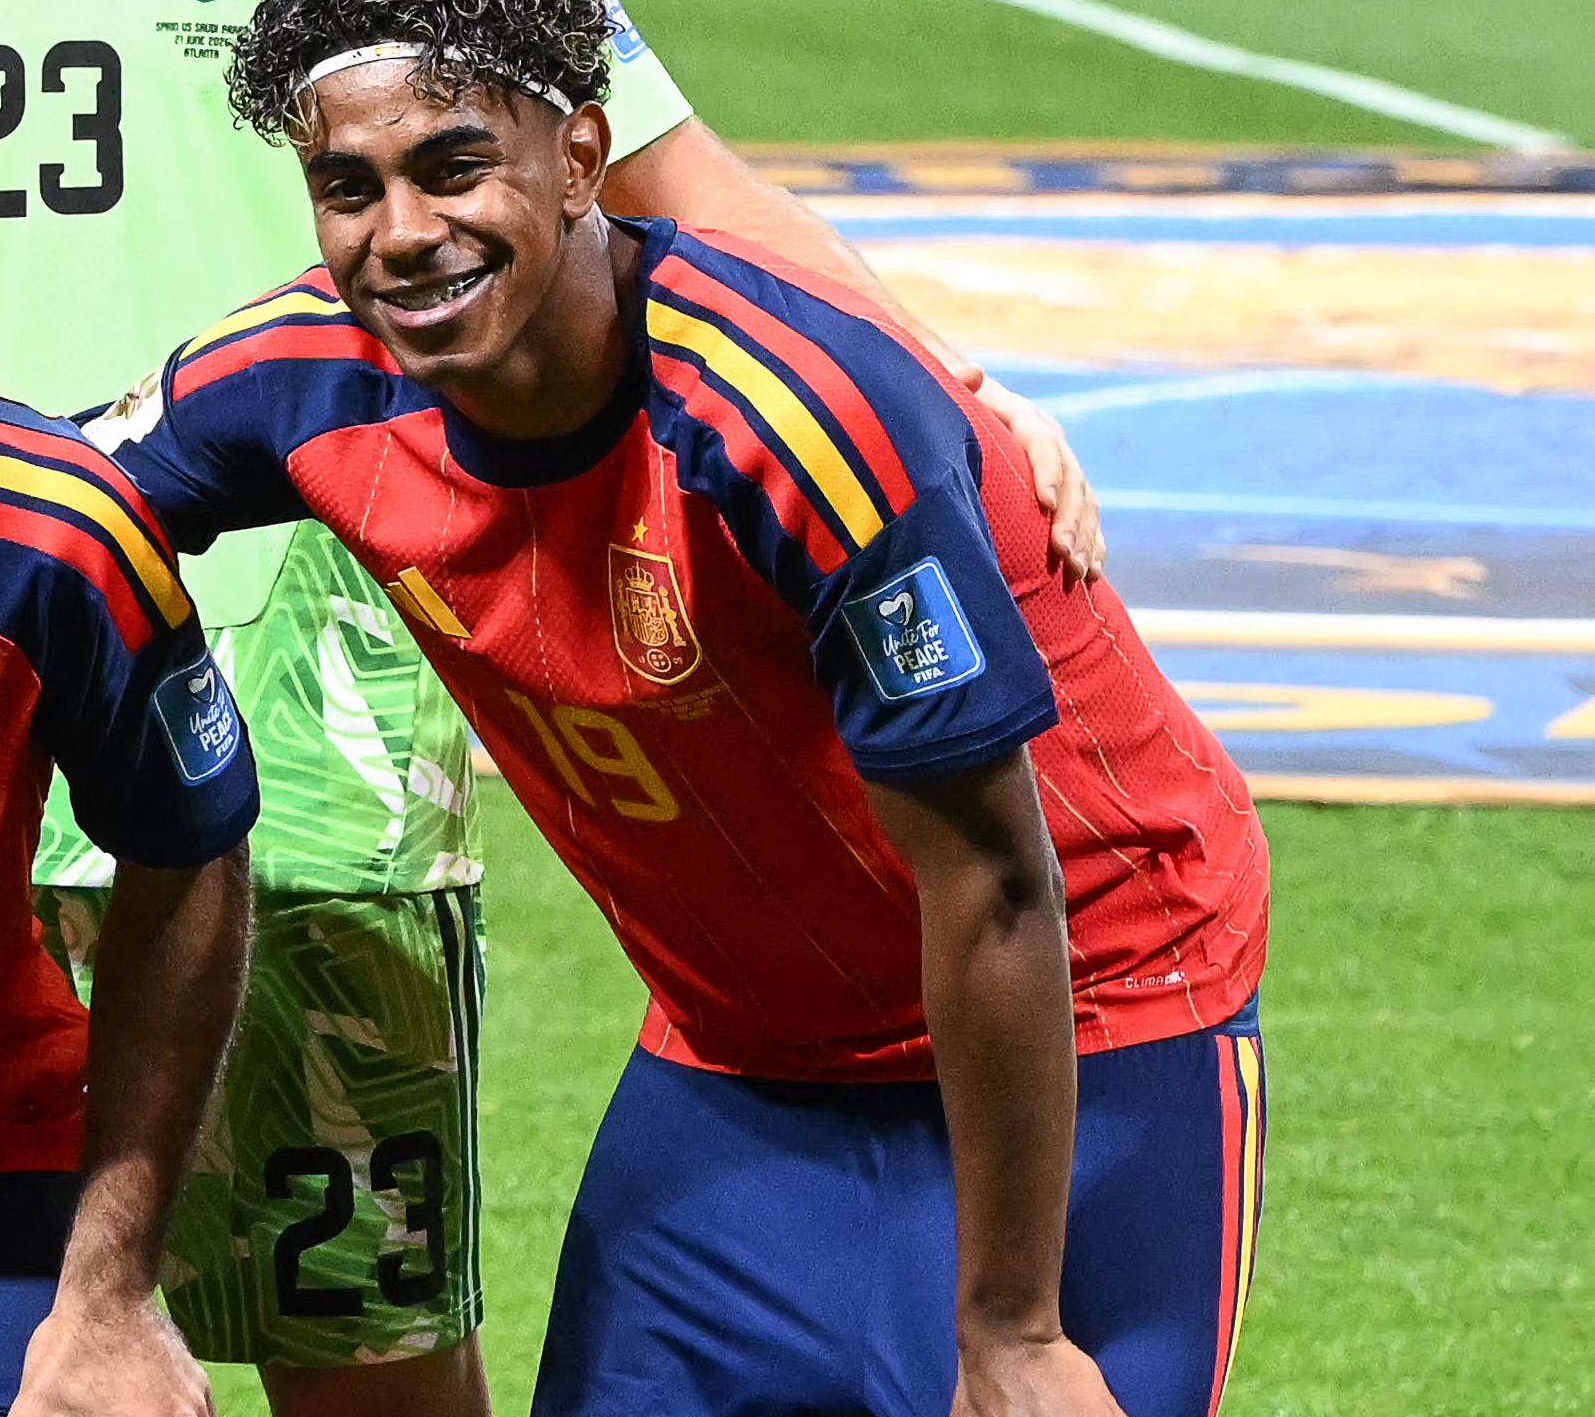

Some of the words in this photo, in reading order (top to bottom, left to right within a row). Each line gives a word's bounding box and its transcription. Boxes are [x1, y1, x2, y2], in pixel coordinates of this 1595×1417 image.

[892, 642, 948, 674] PEACE
[914, 667, 944, 683] FIFA
[504, 689, 680, 821] 19
[265, 1130, 445, 1317] 23
